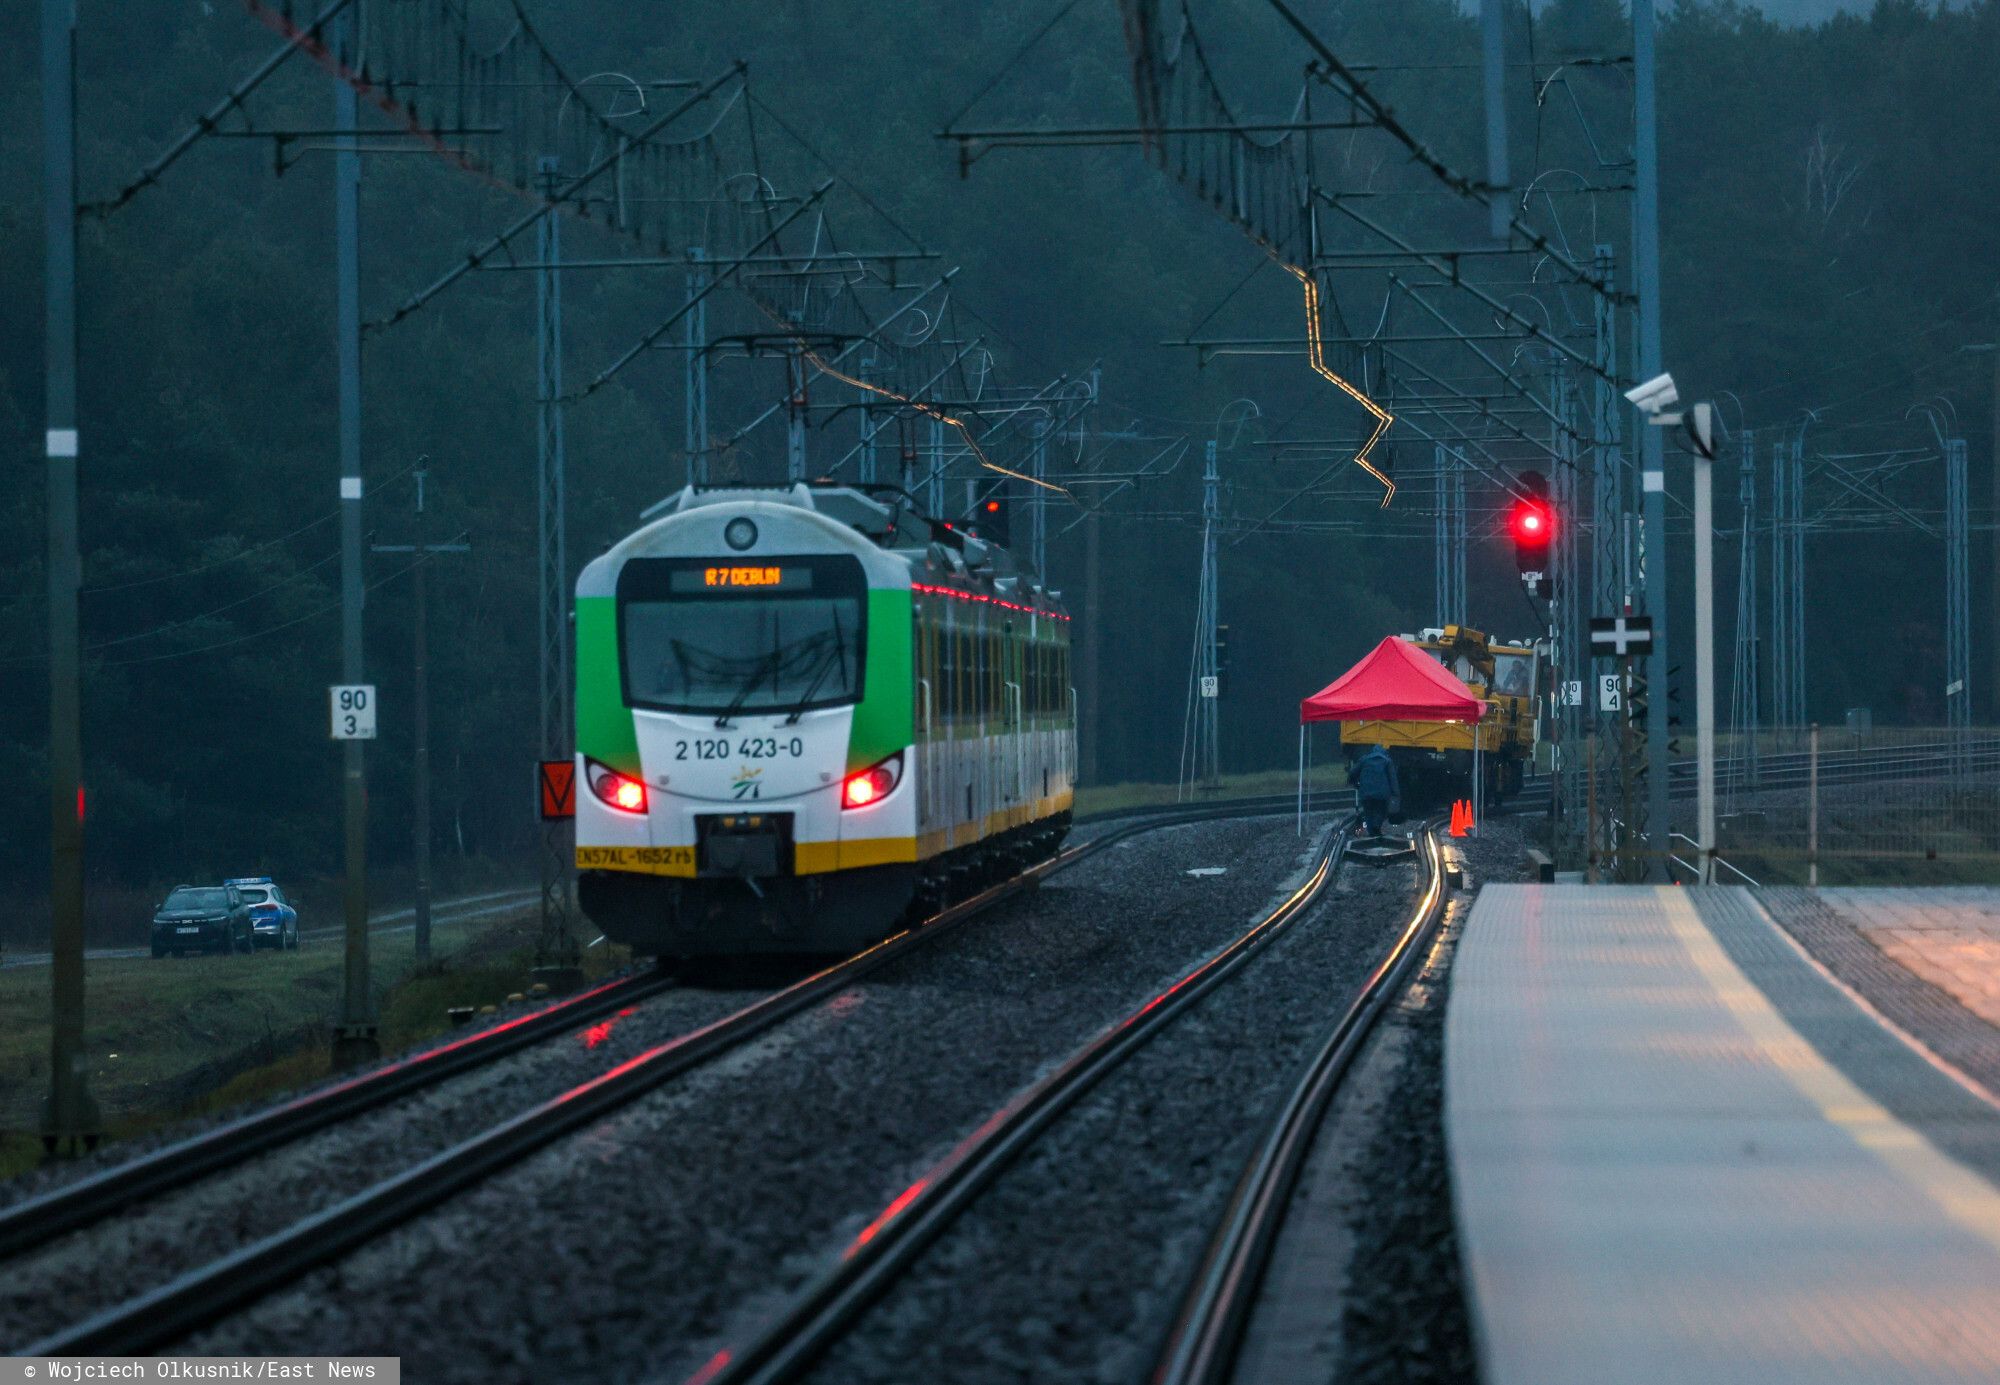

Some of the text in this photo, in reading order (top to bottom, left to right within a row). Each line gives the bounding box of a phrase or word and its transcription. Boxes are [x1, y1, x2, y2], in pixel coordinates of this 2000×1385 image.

[1203, 678, 1215, 687] 90
[340, 690, 366, 711] 90
[1608, 694, 1618, 709] 4
[344, 715, 357, 736] 3
[676, 737, 803, 760] 2 120 423-0
